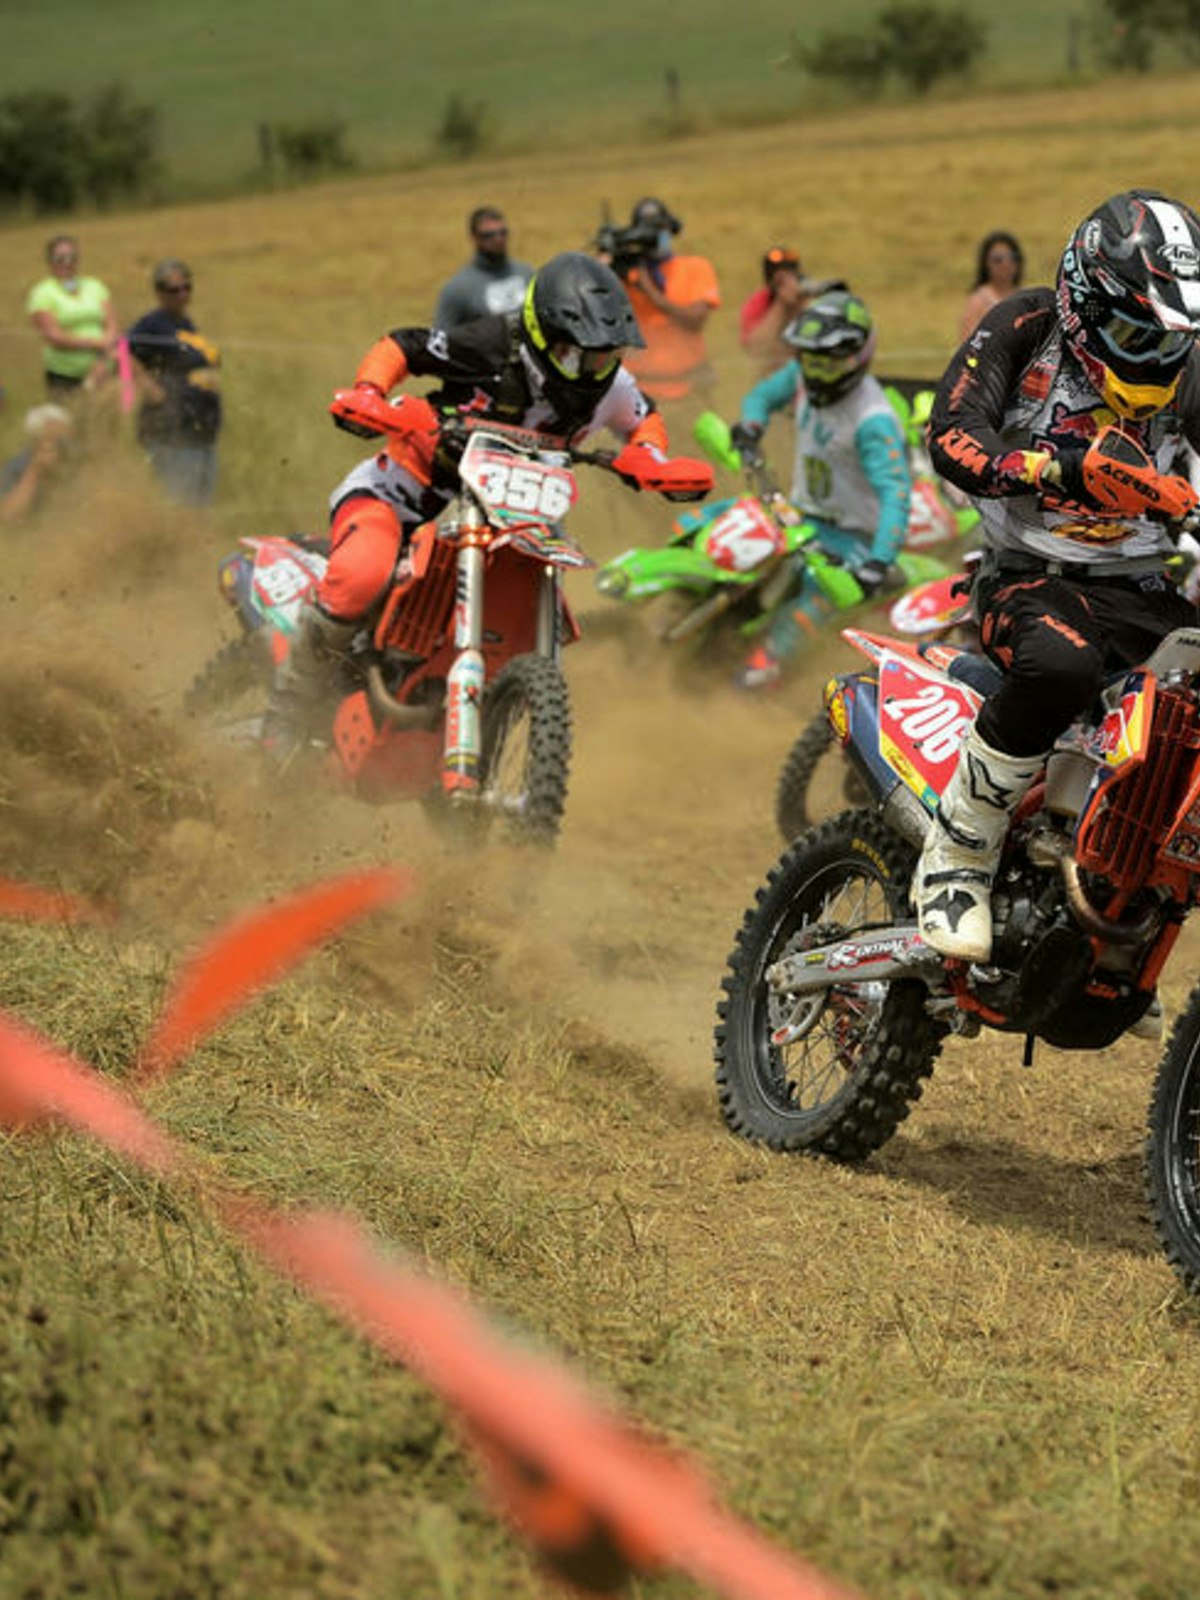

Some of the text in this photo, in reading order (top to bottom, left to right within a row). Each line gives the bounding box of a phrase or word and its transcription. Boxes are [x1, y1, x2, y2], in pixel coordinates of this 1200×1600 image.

[937, 428, 989, 476] KTM
[480, 463, 574, 517] 356
[883, 684, 970, 764] 206
